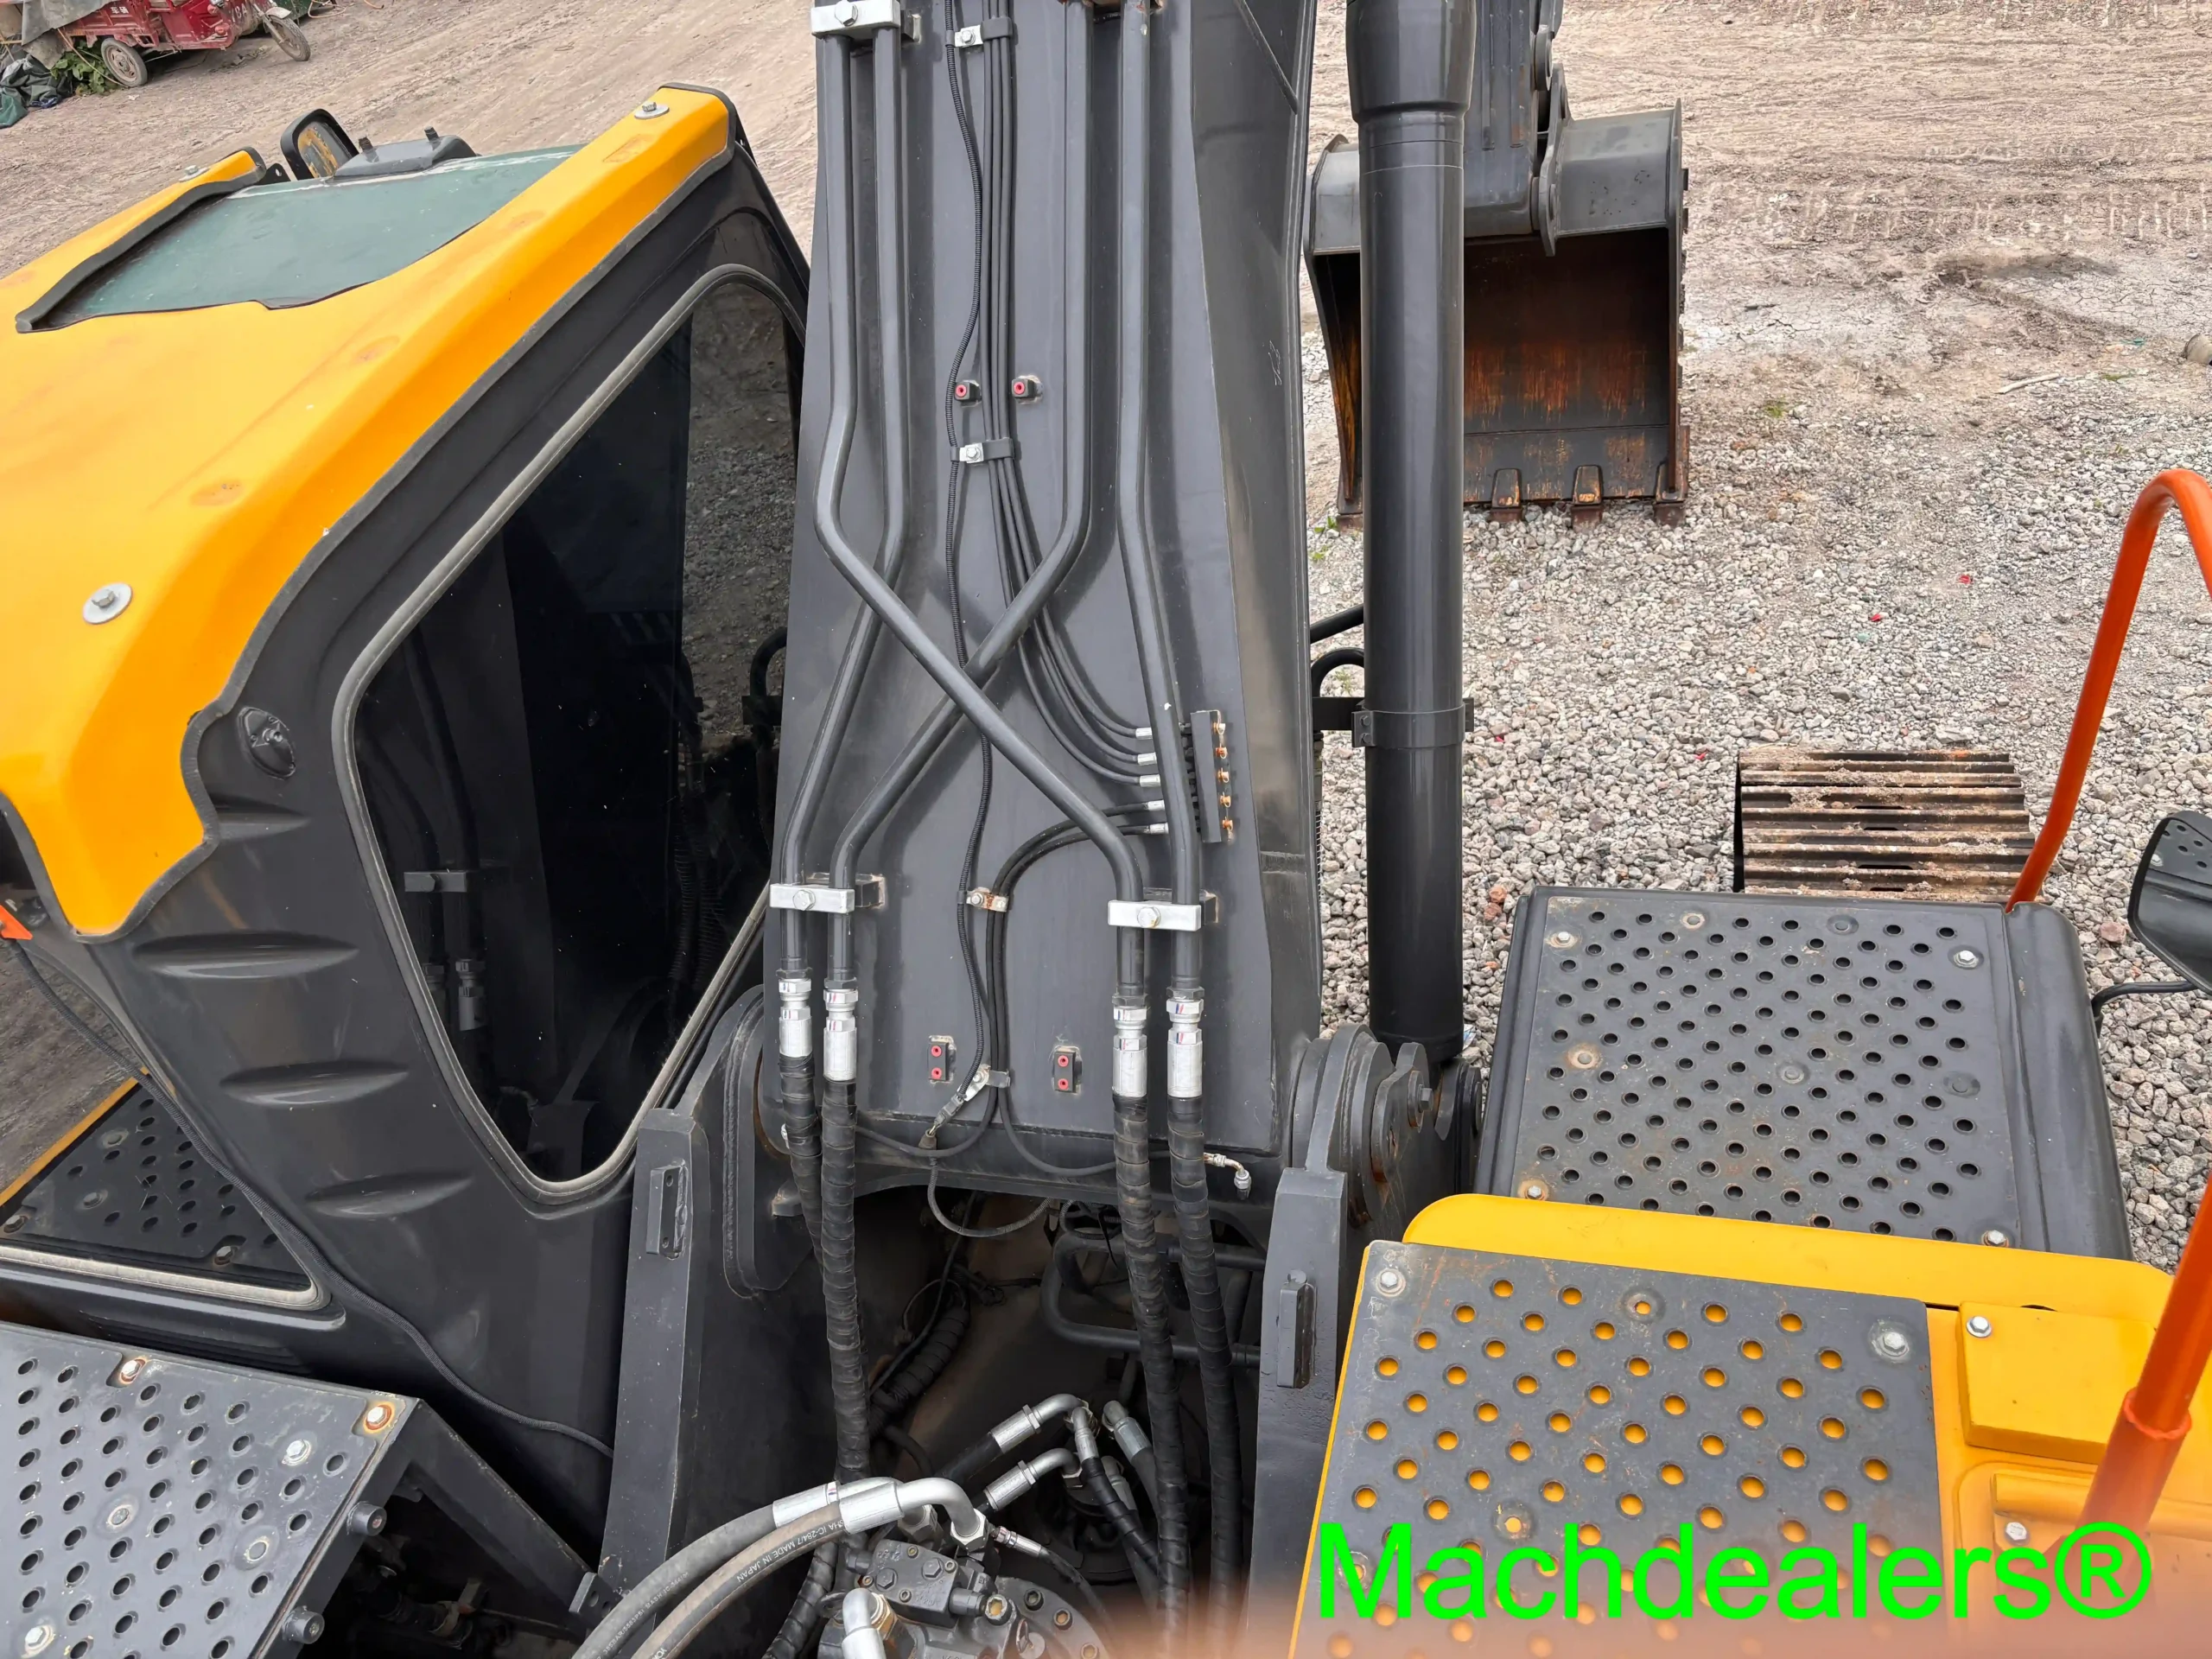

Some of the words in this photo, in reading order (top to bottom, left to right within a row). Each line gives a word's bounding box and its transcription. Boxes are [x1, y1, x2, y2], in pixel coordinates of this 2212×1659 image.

[798, 1527, 827, 1545] IC-284/7
[772, 1542, 795, 1558] MADE
[762, 1555, 772, 1564] IN
[736, 1561, 760, 1582] JAPAN
